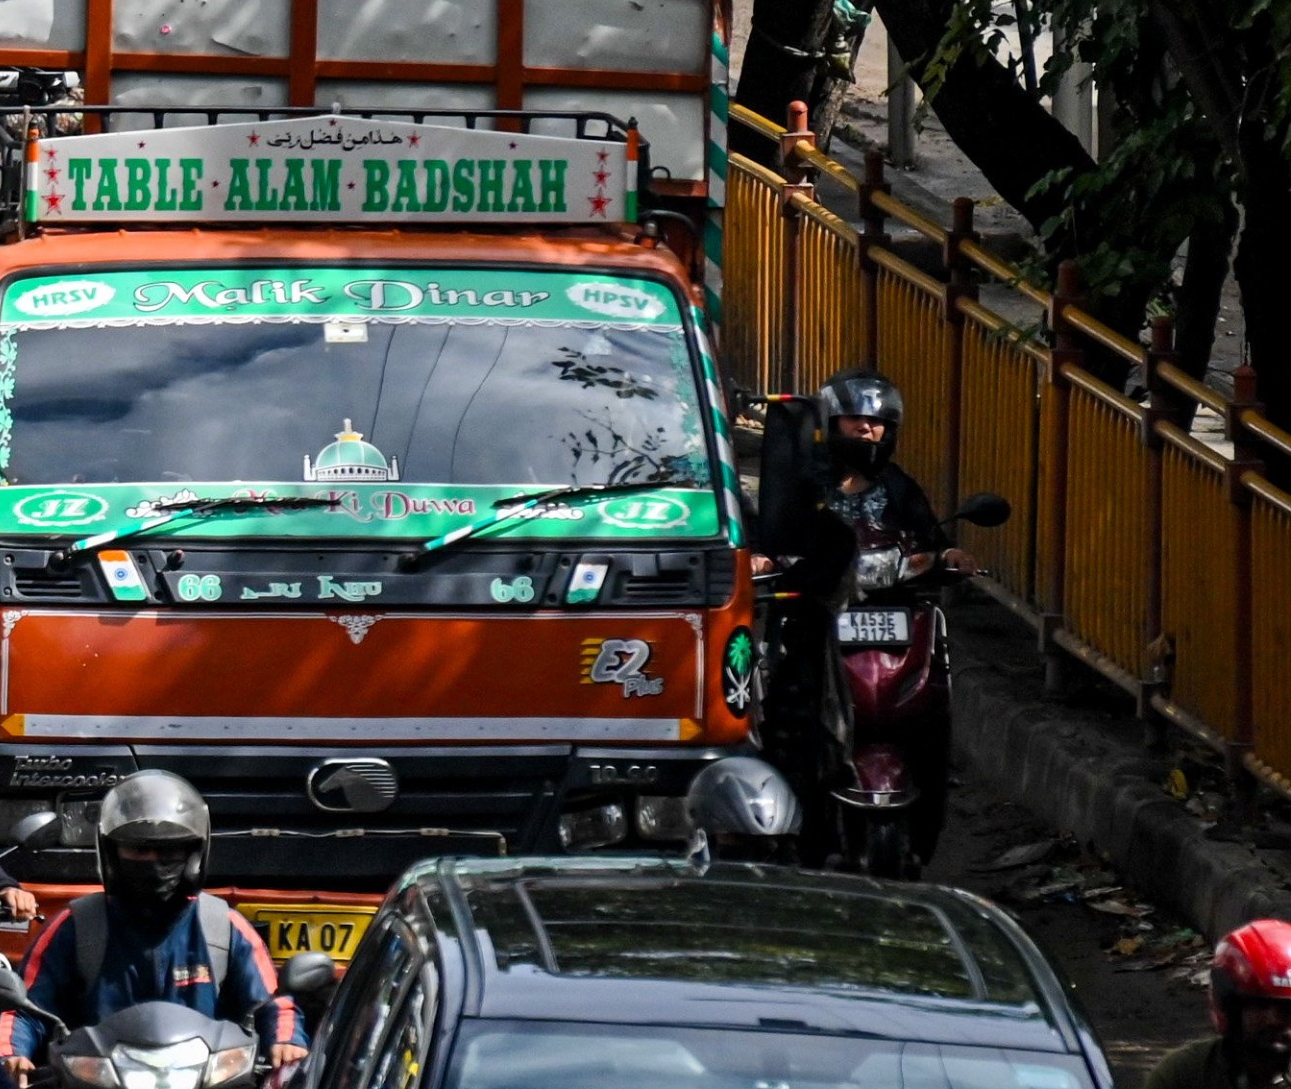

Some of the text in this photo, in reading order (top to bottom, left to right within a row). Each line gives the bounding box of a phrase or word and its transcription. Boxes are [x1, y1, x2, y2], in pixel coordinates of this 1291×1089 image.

[67, 158, 568, 213] TABLE ALAM BADSHAH
[32, 287, 98, 308] HRSV
[133, 278, 551, 312] Malik Dinar
[583, 288, 650, 311] HPSV
[31, 498, 91, 518] JZ
[370, 490, 477, 522] Duwa
[613, 502, 673, 520] JZ
[178, 574, 223, 602] 66
[623, 674, 665, 698] Plus
[15, 755, 73, 770] Turbo
[278, 922, 355, 953] KA 07
